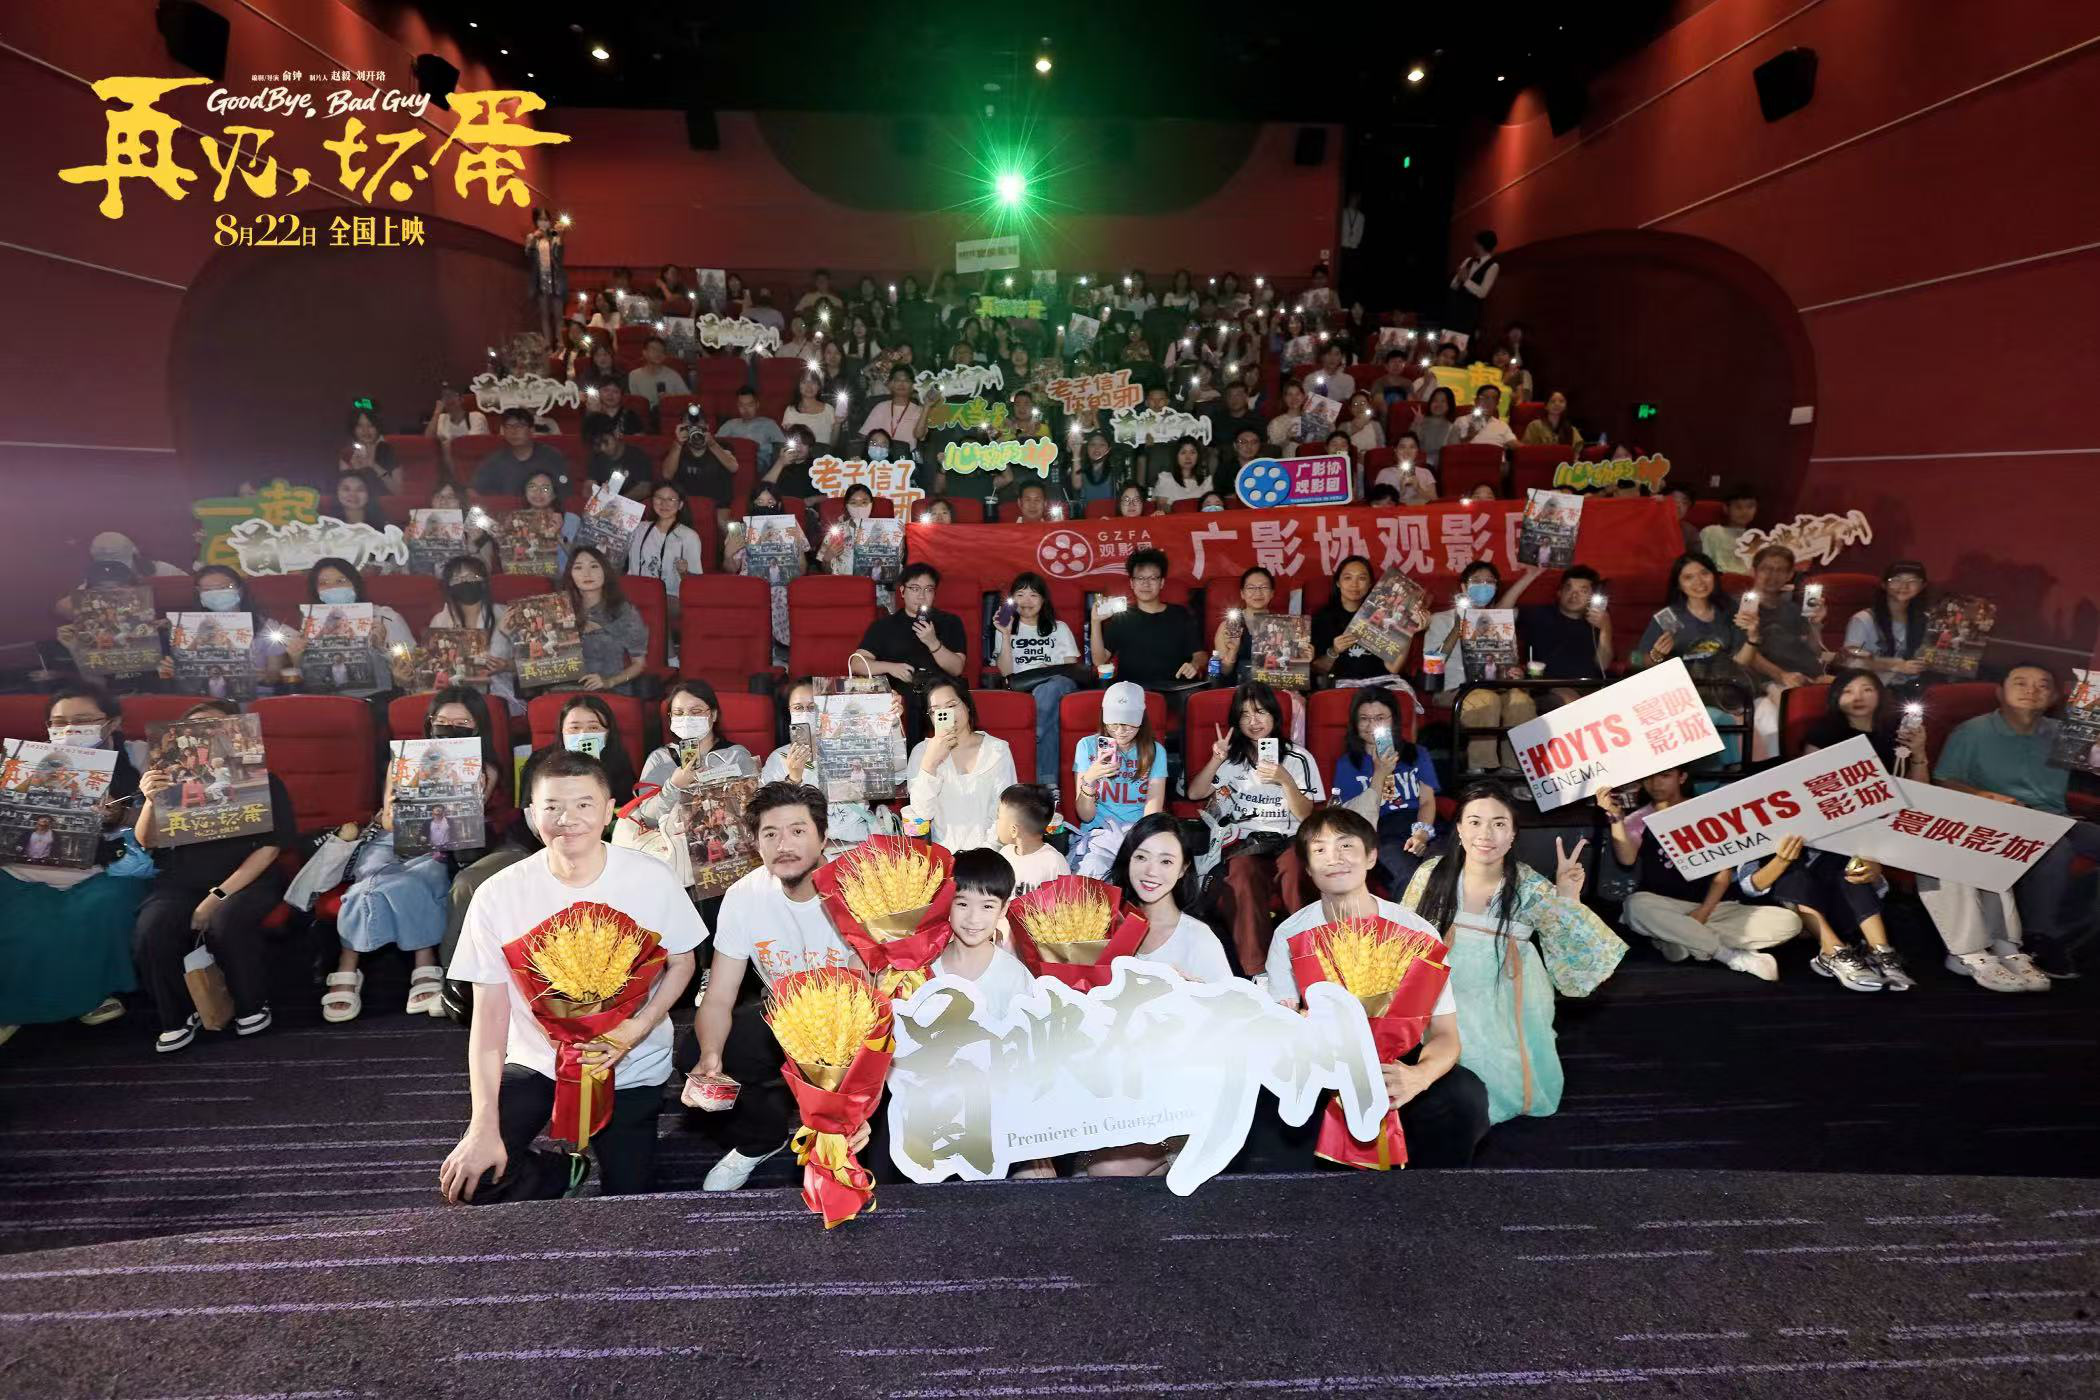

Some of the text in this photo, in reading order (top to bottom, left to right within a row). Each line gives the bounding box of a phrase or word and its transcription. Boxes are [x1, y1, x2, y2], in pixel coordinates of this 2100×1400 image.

[1048, 370, 1131, 398] 老子信了
[811, 458, 914, 491] 老子信了
[1295, 460, 1342, 479] 广影协
[1190, 511, 1523, 580] 广影协观影
[1024, 647, 1044, 655] and
[1528, 714, 1630, 777] HOYTS
[1645, 716, 1714, 756] 影城
[1541, 760, 1608, 796] CINEMA
[1802, 757, 1882, 800] 寰映
[1816, 780, 1896, 821] 影城
[1670, 790, 1801, 855] HOYTS
[1886, 807, 2046, 864] 寰映影城
[1688, 831, 1771, 867] CINEMA
[1006, 1122, 1078, 1148] Premiere
[1082, 1119, 1099, 1137] in
